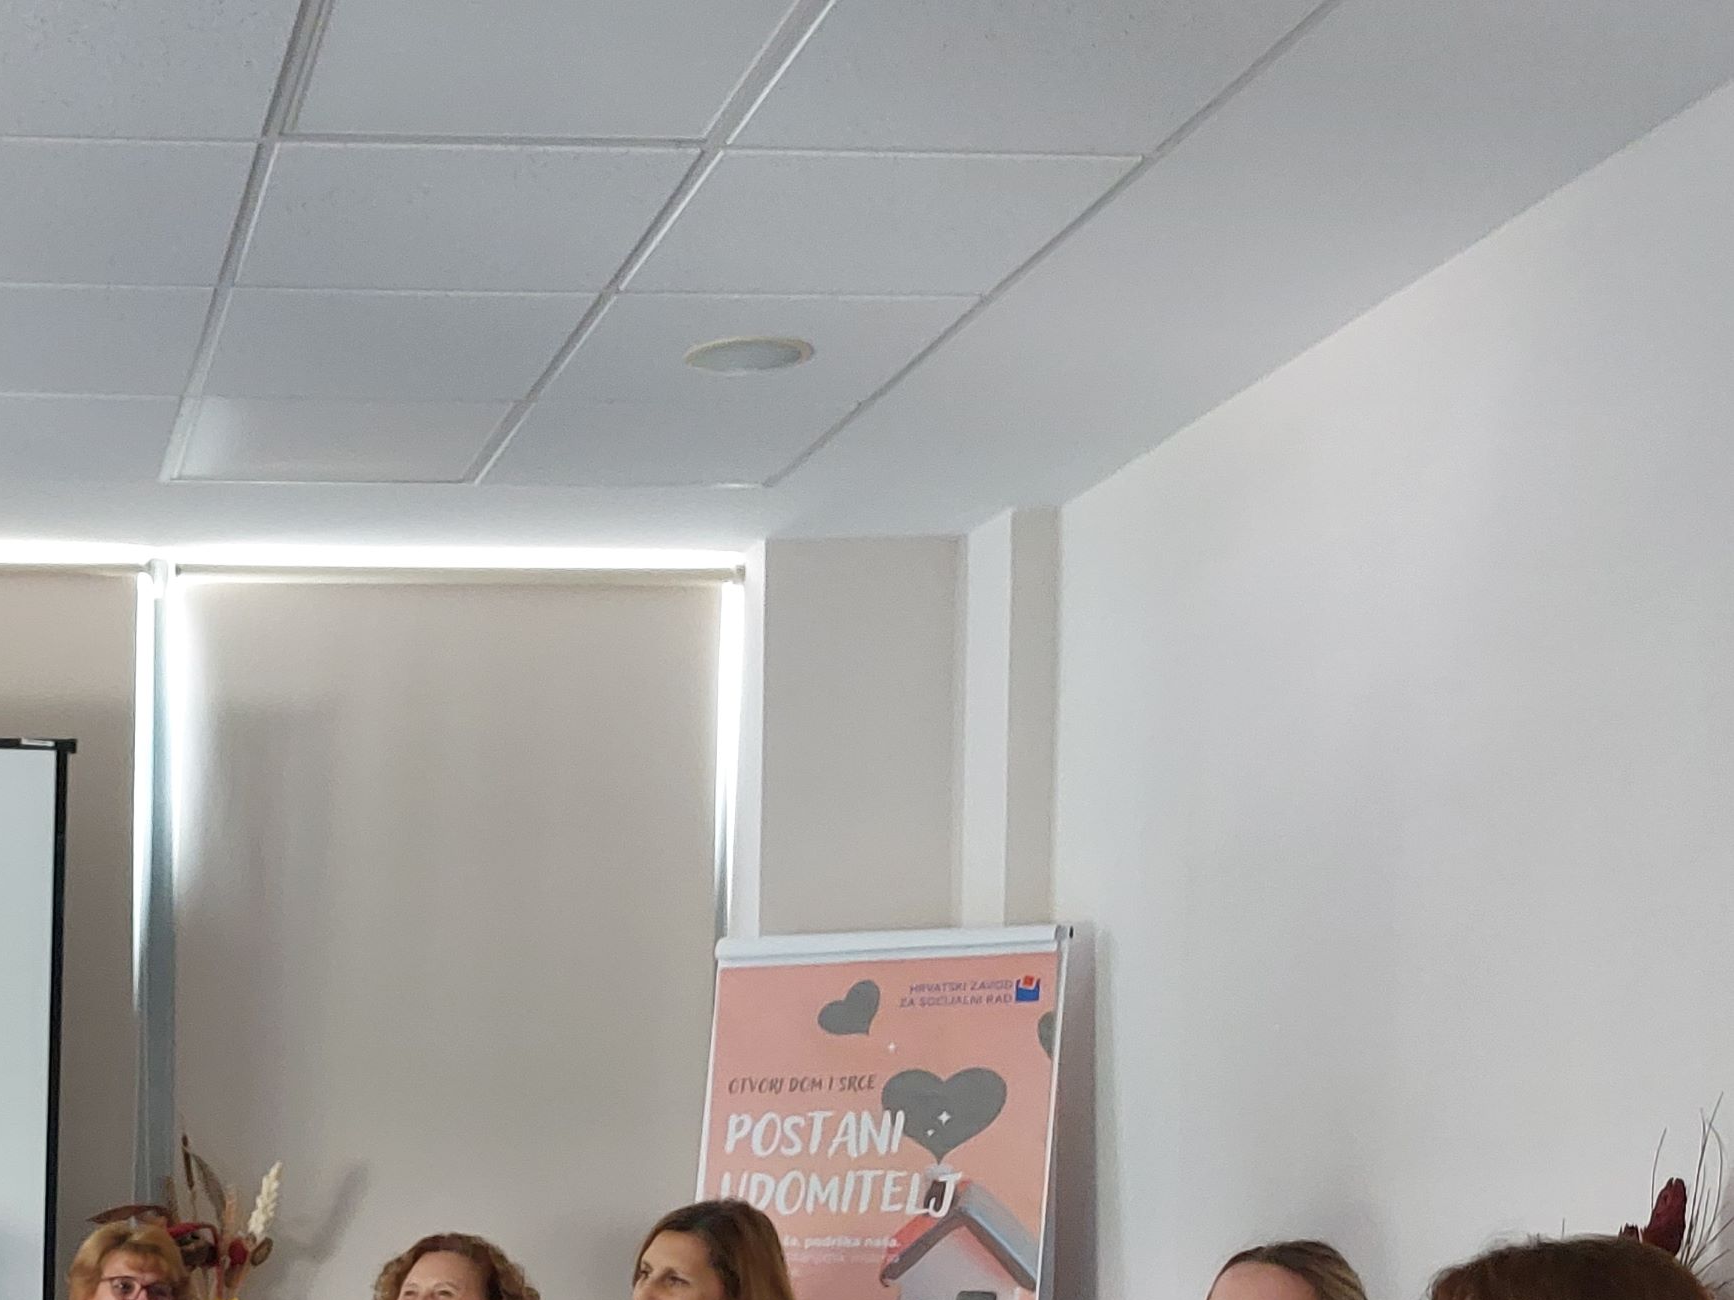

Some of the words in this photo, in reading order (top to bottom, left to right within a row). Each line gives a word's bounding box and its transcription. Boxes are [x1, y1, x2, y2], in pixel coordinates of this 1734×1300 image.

[909, 981, 966, 994] HRVATSKI
[970, 979, 1013, 991] ZAVOD
[900, 997, 916, 1008] ZA
[985, 993, 1013, 1004] RAD
[788, 1075, 823, 1093] DOM
[827, 1075, 834, 1091] I
[839, 1073, 876, 1093] SRCE
[724, 1109, 906, 1159] POSTANI
[719, 1169, 963, 1219] UDOMITELJ
